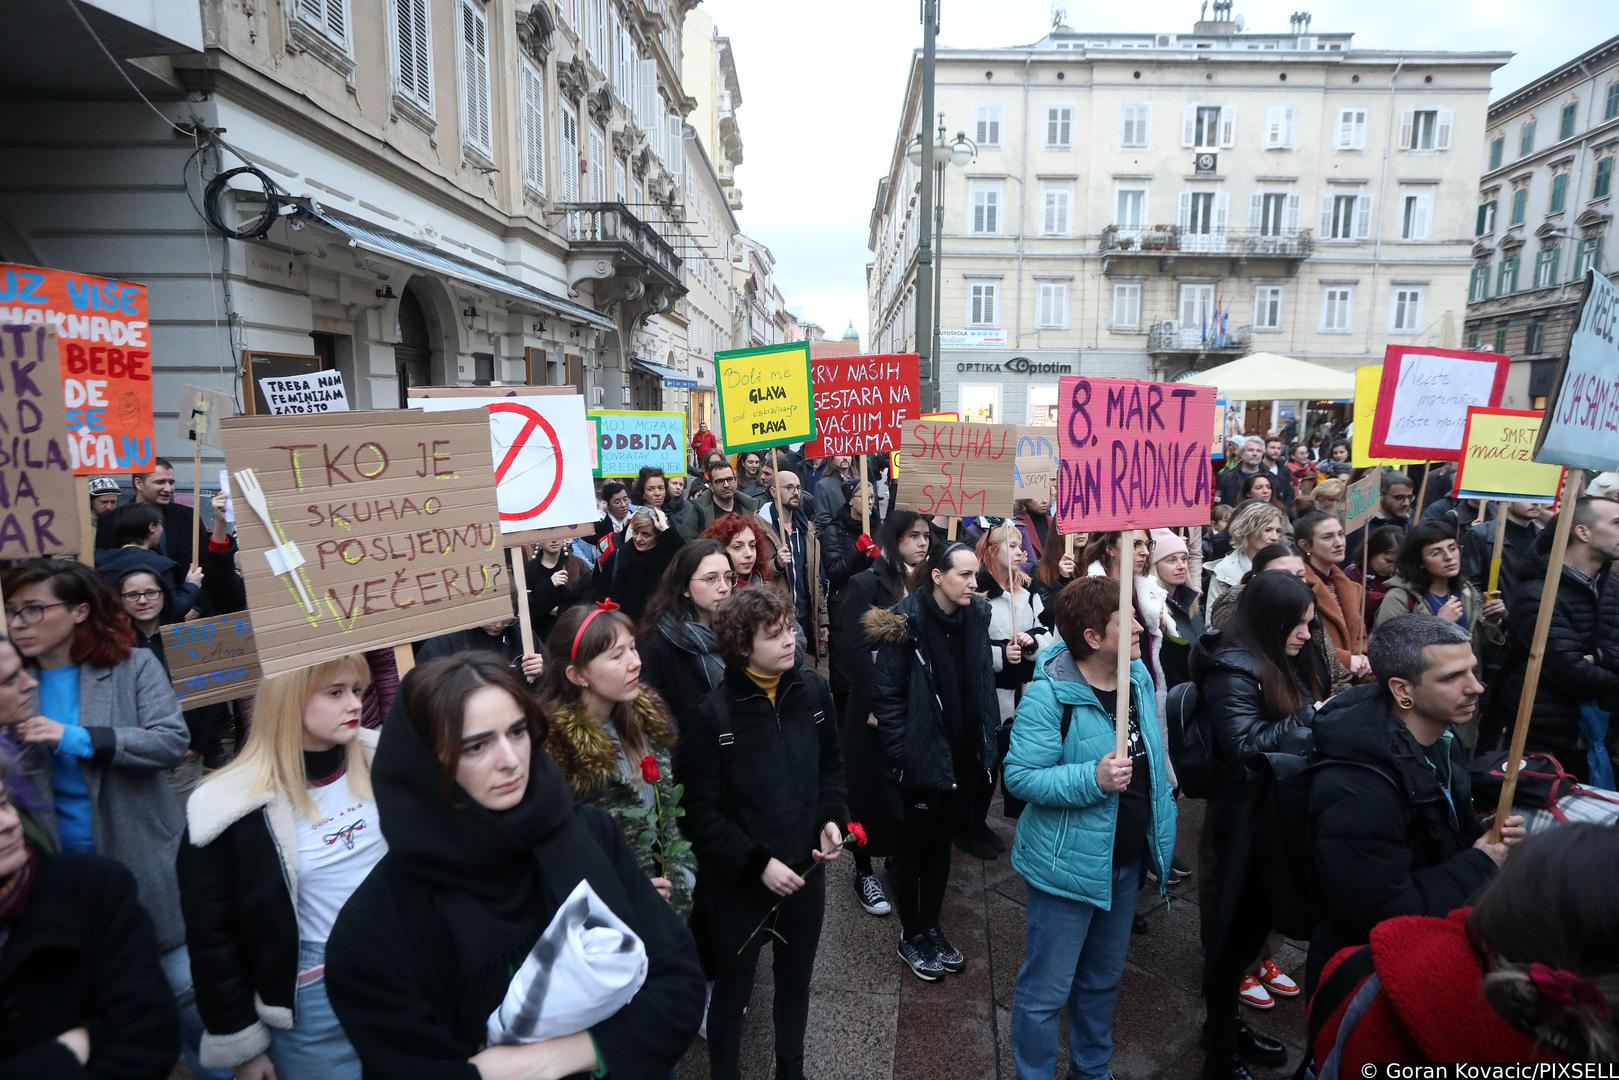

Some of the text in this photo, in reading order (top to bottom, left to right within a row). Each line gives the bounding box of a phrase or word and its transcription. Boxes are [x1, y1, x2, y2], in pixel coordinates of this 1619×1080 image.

[66, 279, 139, 315] VIŠE
[0, 324, 46, 361] TI
[66, 344, 150, 380] BEBE
[847, 359, 899, 382] NAŠIH
[956, 358, 1071, 375] OPTIKA Optotim
[268, 375, 341, 392] TREBA NAM
[271, 389, 344, 405] FEMINIZAM
[749, 385, 787, 404] GLAVA
[275, 401, 328, 415] ZATO ŠTO
[813, 385, 911, 411] SESTARA NA
[752, 419, 787, 436] PRAVA
[888, 408, 907, 429] JE
[1068, 380, 1197, 448] 8. MART
[601, 434, 677, 451] ODBIJA
[823, 431, 894, 455] RUKAMA
[912, 424, 1007, 460] SKUHAJ
[1500, 427, 1537, 445] SMRT
[270, 440, 460, 492] TKO JE
[940, 462, 965, 490] SI
[1060, 439, 1212, 520] DAN RADNICA
[307, 497, 442, 530] SKUHAO
[918, 485, 985, 515] SAM
[316, 522, 496, 570] POSLJEDNJU
[324, 563, 502, 632] VEČERU?
